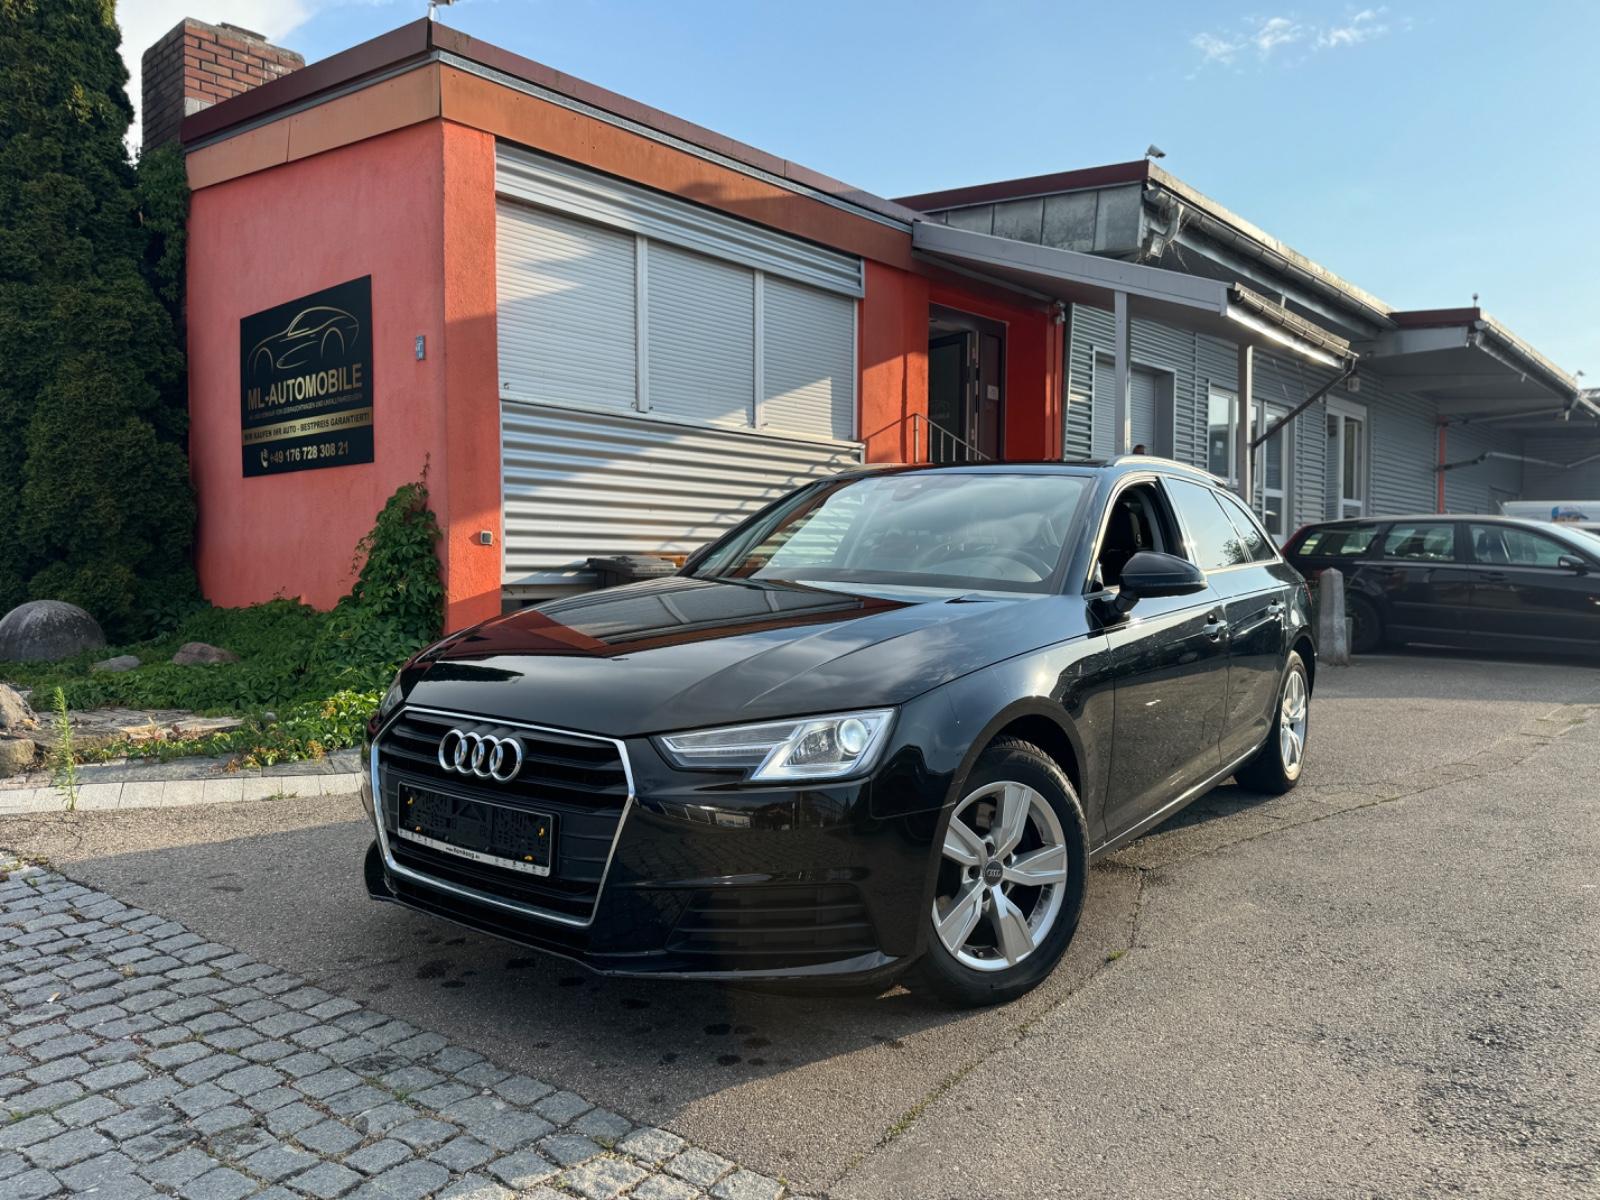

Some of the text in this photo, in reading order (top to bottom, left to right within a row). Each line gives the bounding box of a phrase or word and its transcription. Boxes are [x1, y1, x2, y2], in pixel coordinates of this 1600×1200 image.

[248, 363, 362, 411] ML-AUTOMOBILE
[283, 425, 296, 435] AUTO
[300, 418, 330, 432] BESTPREIS
[270, 441, 349, 464] +49 176 728 308 21
